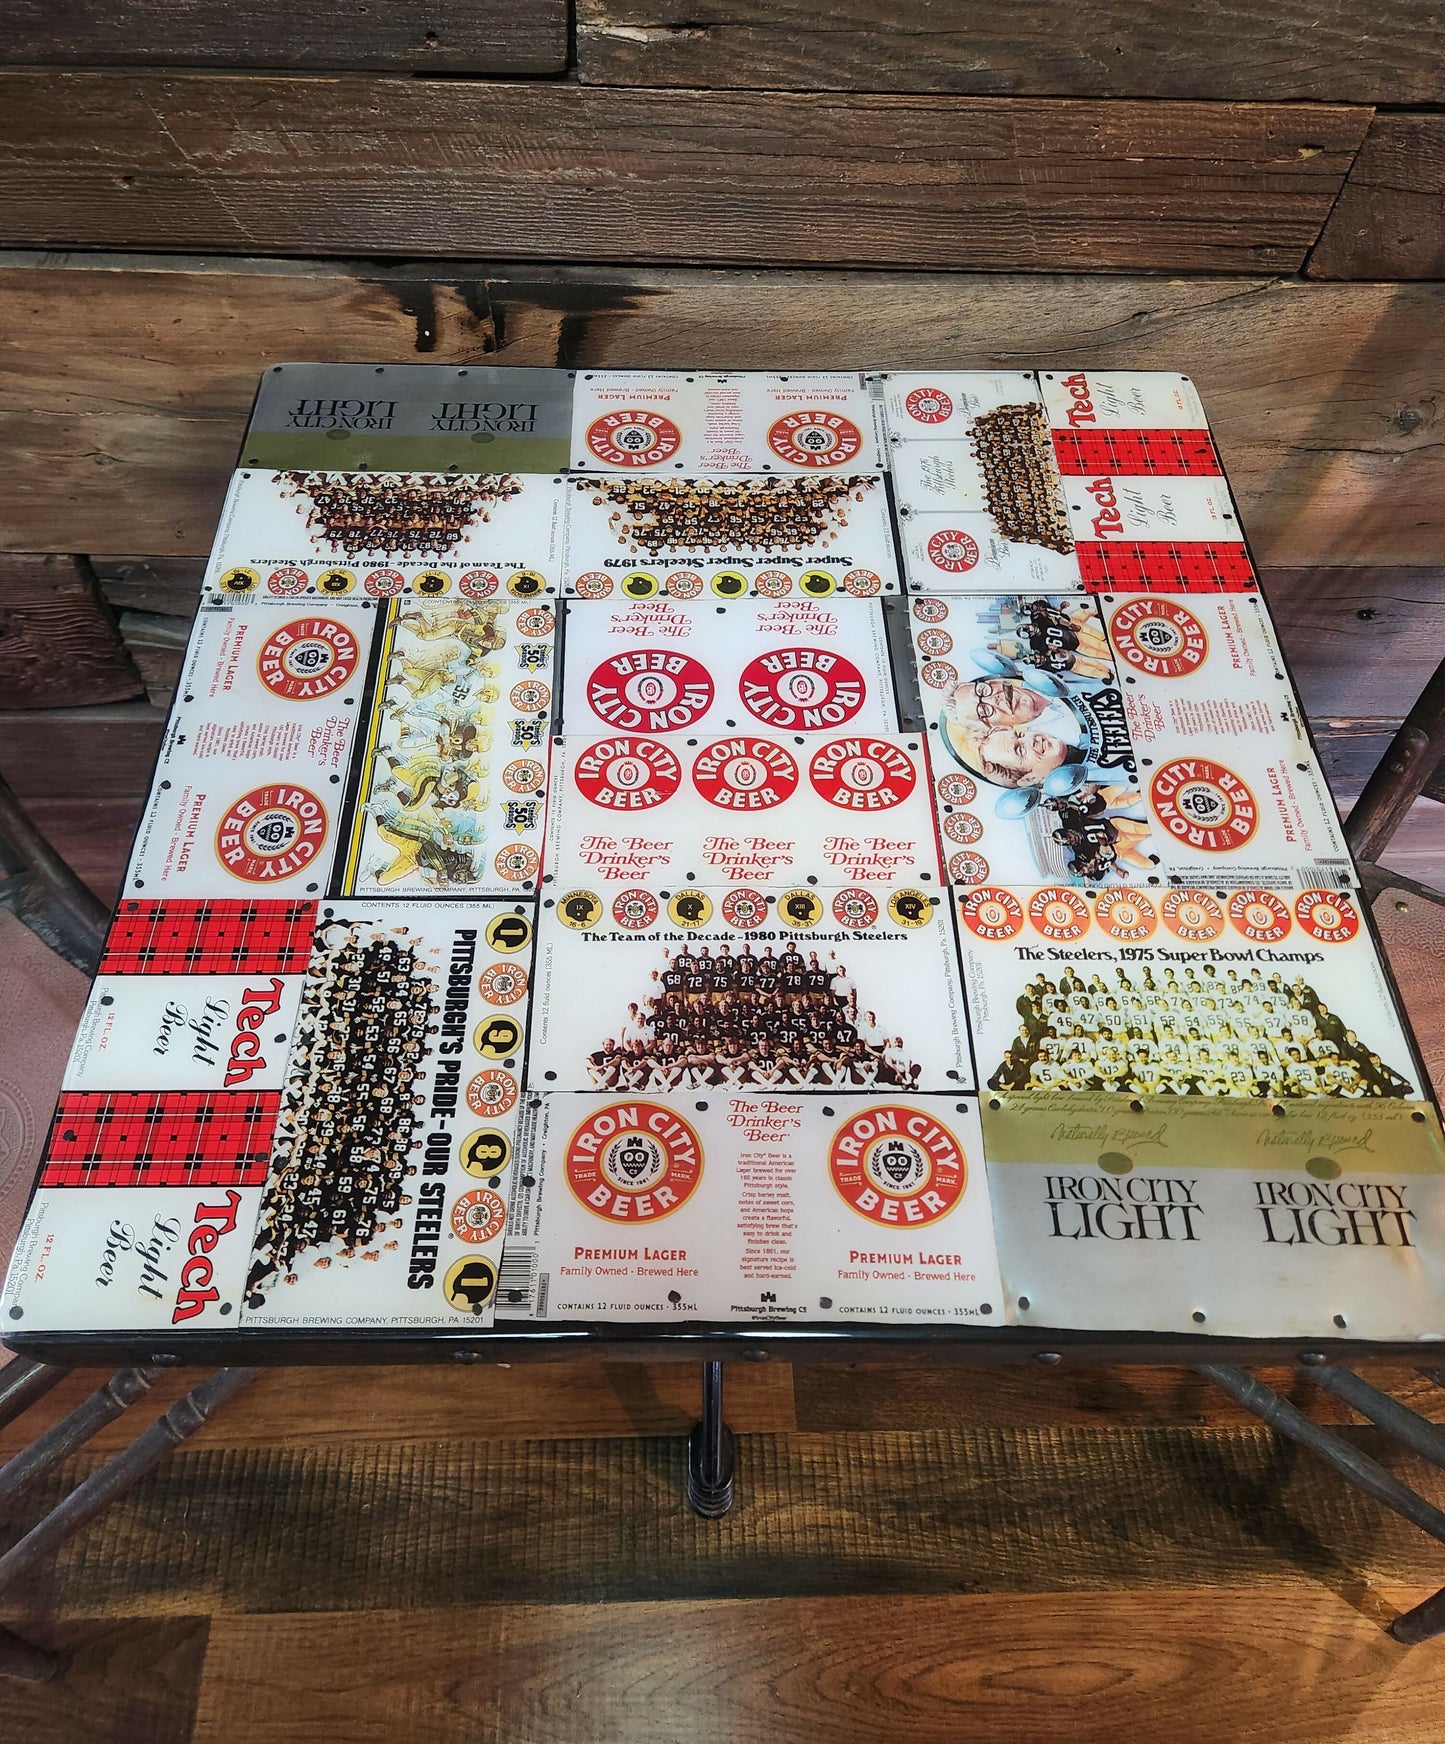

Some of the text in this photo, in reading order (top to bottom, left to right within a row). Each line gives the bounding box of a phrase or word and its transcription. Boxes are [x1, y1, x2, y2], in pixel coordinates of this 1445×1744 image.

[288, 399, 400, 417] LIGHT
[908, 389, 938, 422] IRON CITY
[936, 392, 951, 417] BEER
[1061, 373, 1096, 428] Tech
[1096, 382, 1125, 417] Light
[1127, 387, 1146, 415] Beer
[285, 415, 393, 429] IRON CITY
[432, 402, 540, 420] LIGHT
[603, 413, 664, 428] BEER
[429, 419, 535, 432] IRON CITY
[592, 435, 676, 464] IRON CITY
[698, 462, 752, 470] The Beer
[1085, 477, 1123, 539] Tech
[1123, 488, 1155, 528] Light
[1157, 494, 1177, 525] Beer
[250, 558, 298, 568] Steelers
[300, 558, 360, 570] Pittsburgh
[438, 560, 453, 568] the
[504, 561, 526, 569] The
[604, 555, 852, 568] Super Super Super Steelers 1979
[611, 612, 692, 624] Drinker's
[629, 603, 674, 613] Beer
[608, 626, 691, 637] The Beer
[262, 631, 293, 685] BEER
[298, 622, 353, 696] IRON CITY
[610, 653, 688, 675] BEER
[760, 652, 837, 673] BEER
[592, 683, 709, 730] IRON CITY
[744, 681, 861, 727] IRON CITY
[318, 716, 337, 766] Drinker's
[1082, 688, 1137, 772] STEELERS
[308, 726, 322, 757] Beer
[331, 717, 350, 768] The Beer
[579, 740, 677, 781] IRON CITY
[696, 740, 795, 782] IRON CITY
[814, 741, 912, 781] IRON CITY
[594, 787, 662, 808] BEER
[714, 788, 780, 808] BEER
[832, 788, 899, 808] BEER
[1156, 763, 1217, 847] IRON CITY
[1218, 773, 1253, 836] BEER
[515, 808, 527, 823] 50
[177, 794, 206, 872] PREMIUM LAGER
[580, 836, 673, 850] The Beer
[703, 836, 796, 850] The Beer
[824, 837, 916, 850] The Beer
[579, 852, 670, 868] Drinker's
[702, 852, 794, 868] Drinker's
[824, 853, 915, 868] Drinker's
[598, 867, 650, 880] Beer
[722, 868, 774, 880] Beer
[844, 868, 896, 880] Beer
[561, 892, 598, 905] MINNESOTA
[675, 891, 705, 901] DALLAS
[1031, 891, 1088, 919] IRON CITY
[581, 932, 607, 942] The
[608, 932, 648, 942] Team
[650, 932, 662, 942] of
[663, 932, 685, 942] the
[779, 931, 850, 942] Pittsburgh
[852, 930, 908, 941] Steelers
[1043, 925, 1082, 939] BEER
[1014, 946, 1324, 964] The Steelers, 1975 Super Bowl Champs
[438, 930, 478, 1055] PITTSBURGH'S
[153, 1001, 188, 1056] Beer
[189, 996, 230, 1067] Light
[224, 978, 284, 1088] Tech
[729, 1100, 804, 1113] The Beer
[727, 1115, 801, 1129] Drinker's
[573, 1108, 695, 1166] IRON CITY
[744, 1130, 787, 1141] Beer
[836, 1111, 959, 1170] IRON CITY
[1043, 1176, 1199, 1203] IRON CITY
[1252, 1181, 1408, 1209] IRON CITY
[587, 1185, 678, 1217] BEER
[855, 1188, 947, 1222] BEER
[1043, 1201, 1204, 1242] LIGHT
[1256, 1207, 1417, 1248] LIGHT
[46, 1234, 54, 1243] 12
[408, 1182, 445, 1290] STEELERS
[95, 1220, 135, 1287] Beer
[135, 1213, 181, 1299] Light
[172, 1189, 242, 1324] Tech
[575, 1247, 687, 1261] PREMIUM LAGER
[850, 1251, 962, 1265] PREMIUM LAGER
[560, 1266, 698, 1277] Family Owned Brewed Here
